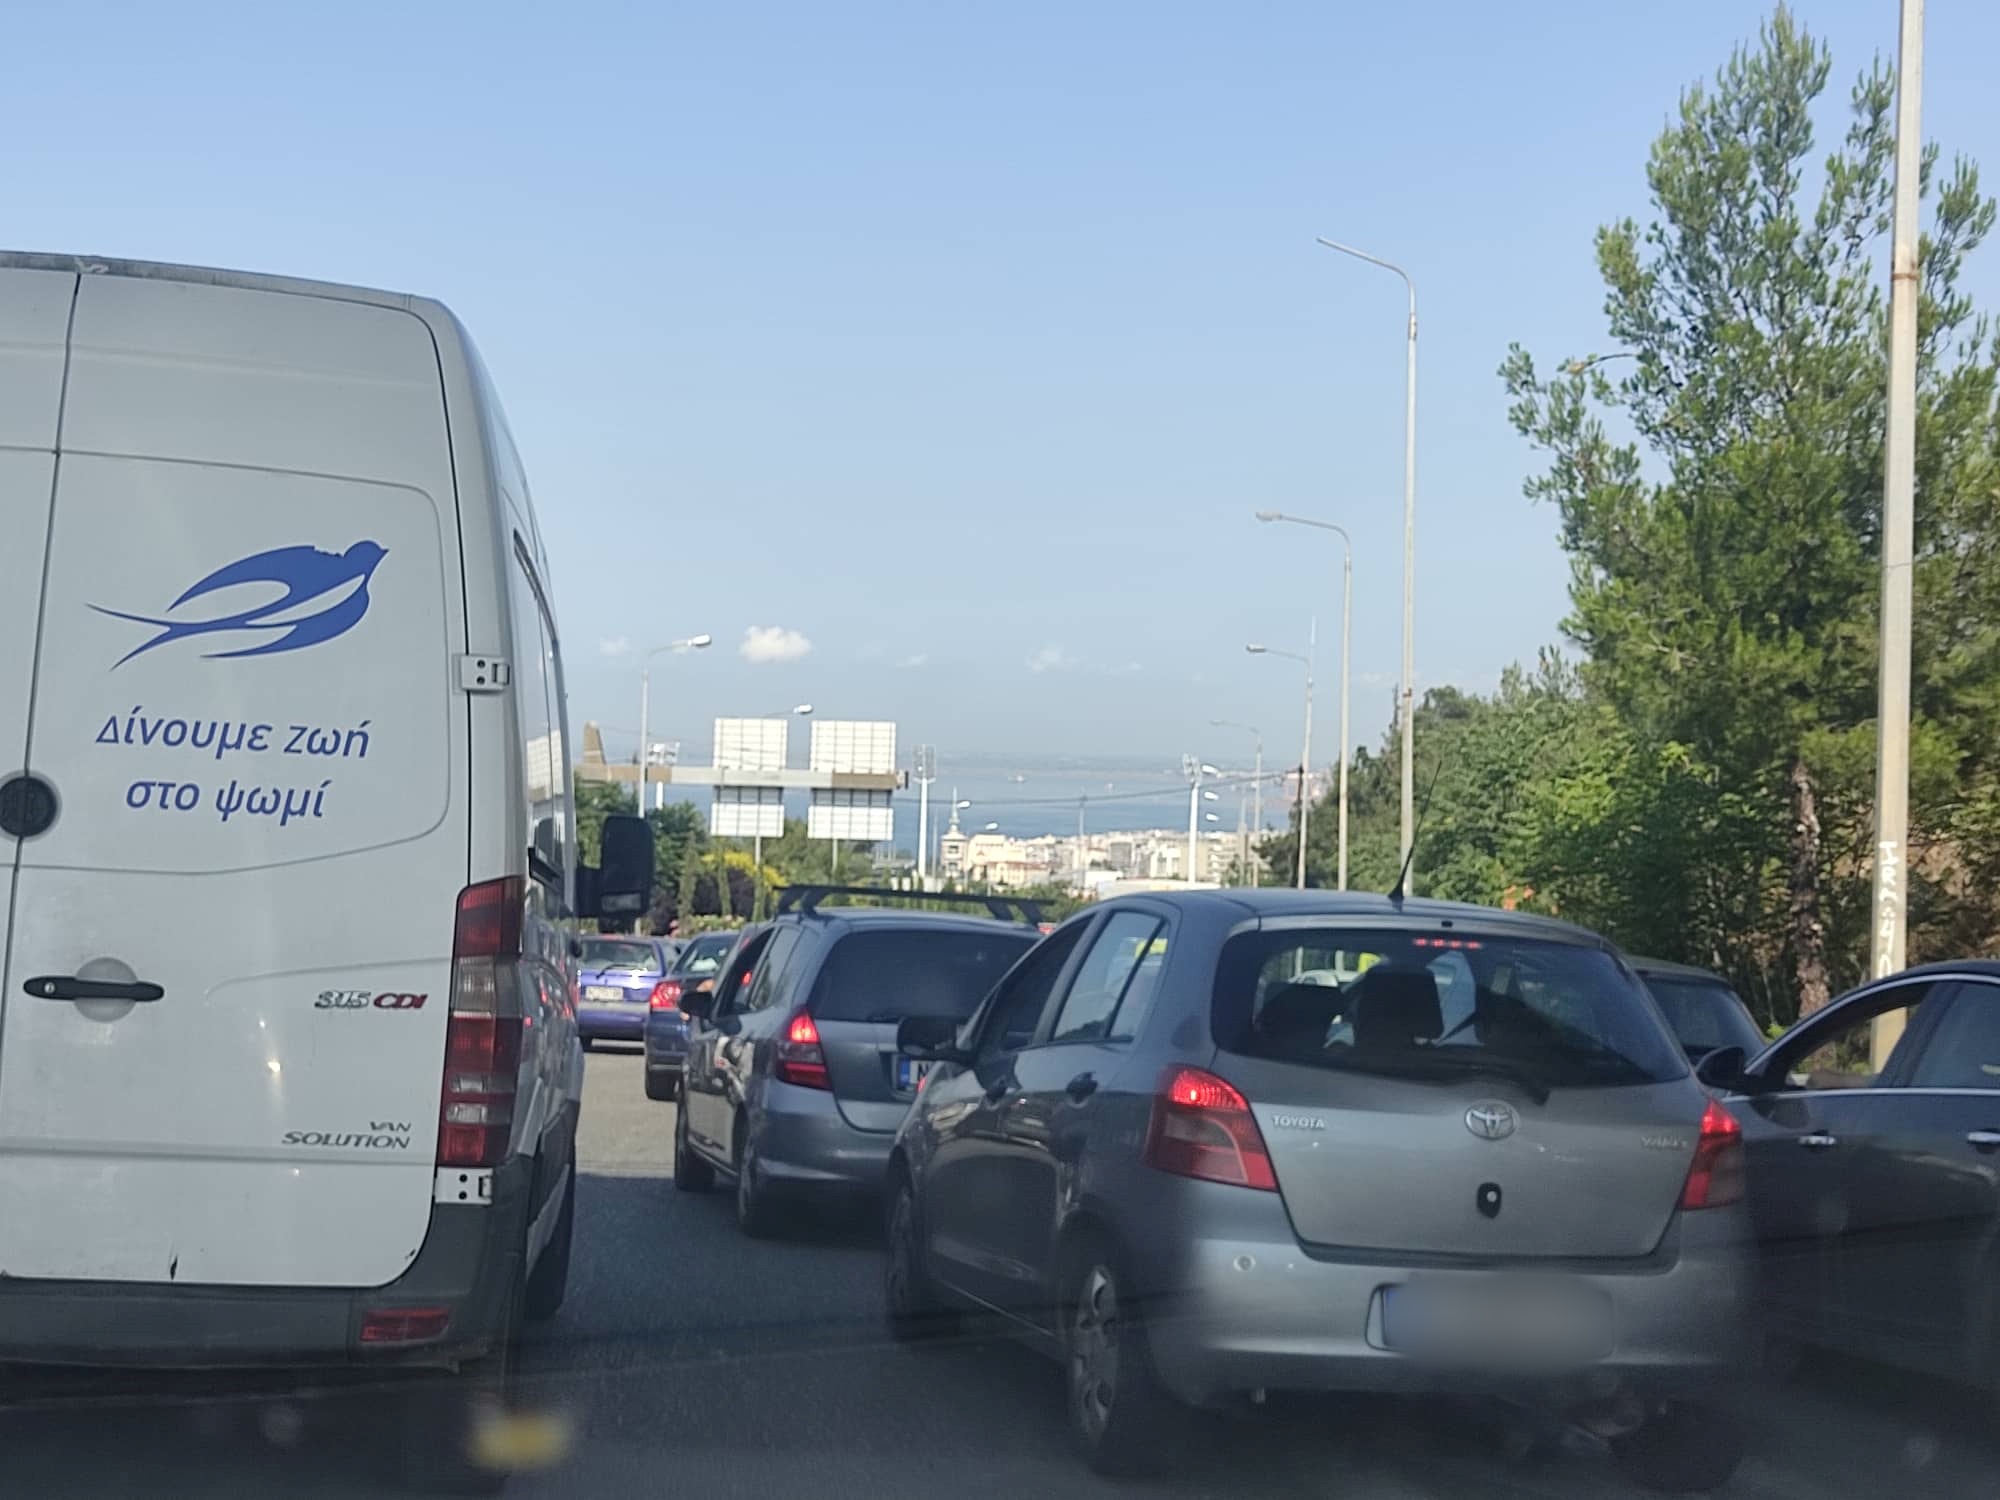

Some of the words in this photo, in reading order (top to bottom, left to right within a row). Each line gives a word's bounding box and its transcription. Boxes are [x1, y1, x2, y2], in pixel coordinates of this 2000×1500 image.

[96, 706, 273, 760] Δίνουμε
[126, 781, 200, 811] στο
[215, 780, 332, 827] ψωμί
[314, 990, 371, 1010] 315
[373, 992, 428, 1010] CDI
[369, 1121, 411, 1133] VAN
[1271, 1113, 1326, 1129] TOYOTA
[282, 1132, 411, 1149] SOLUTION
